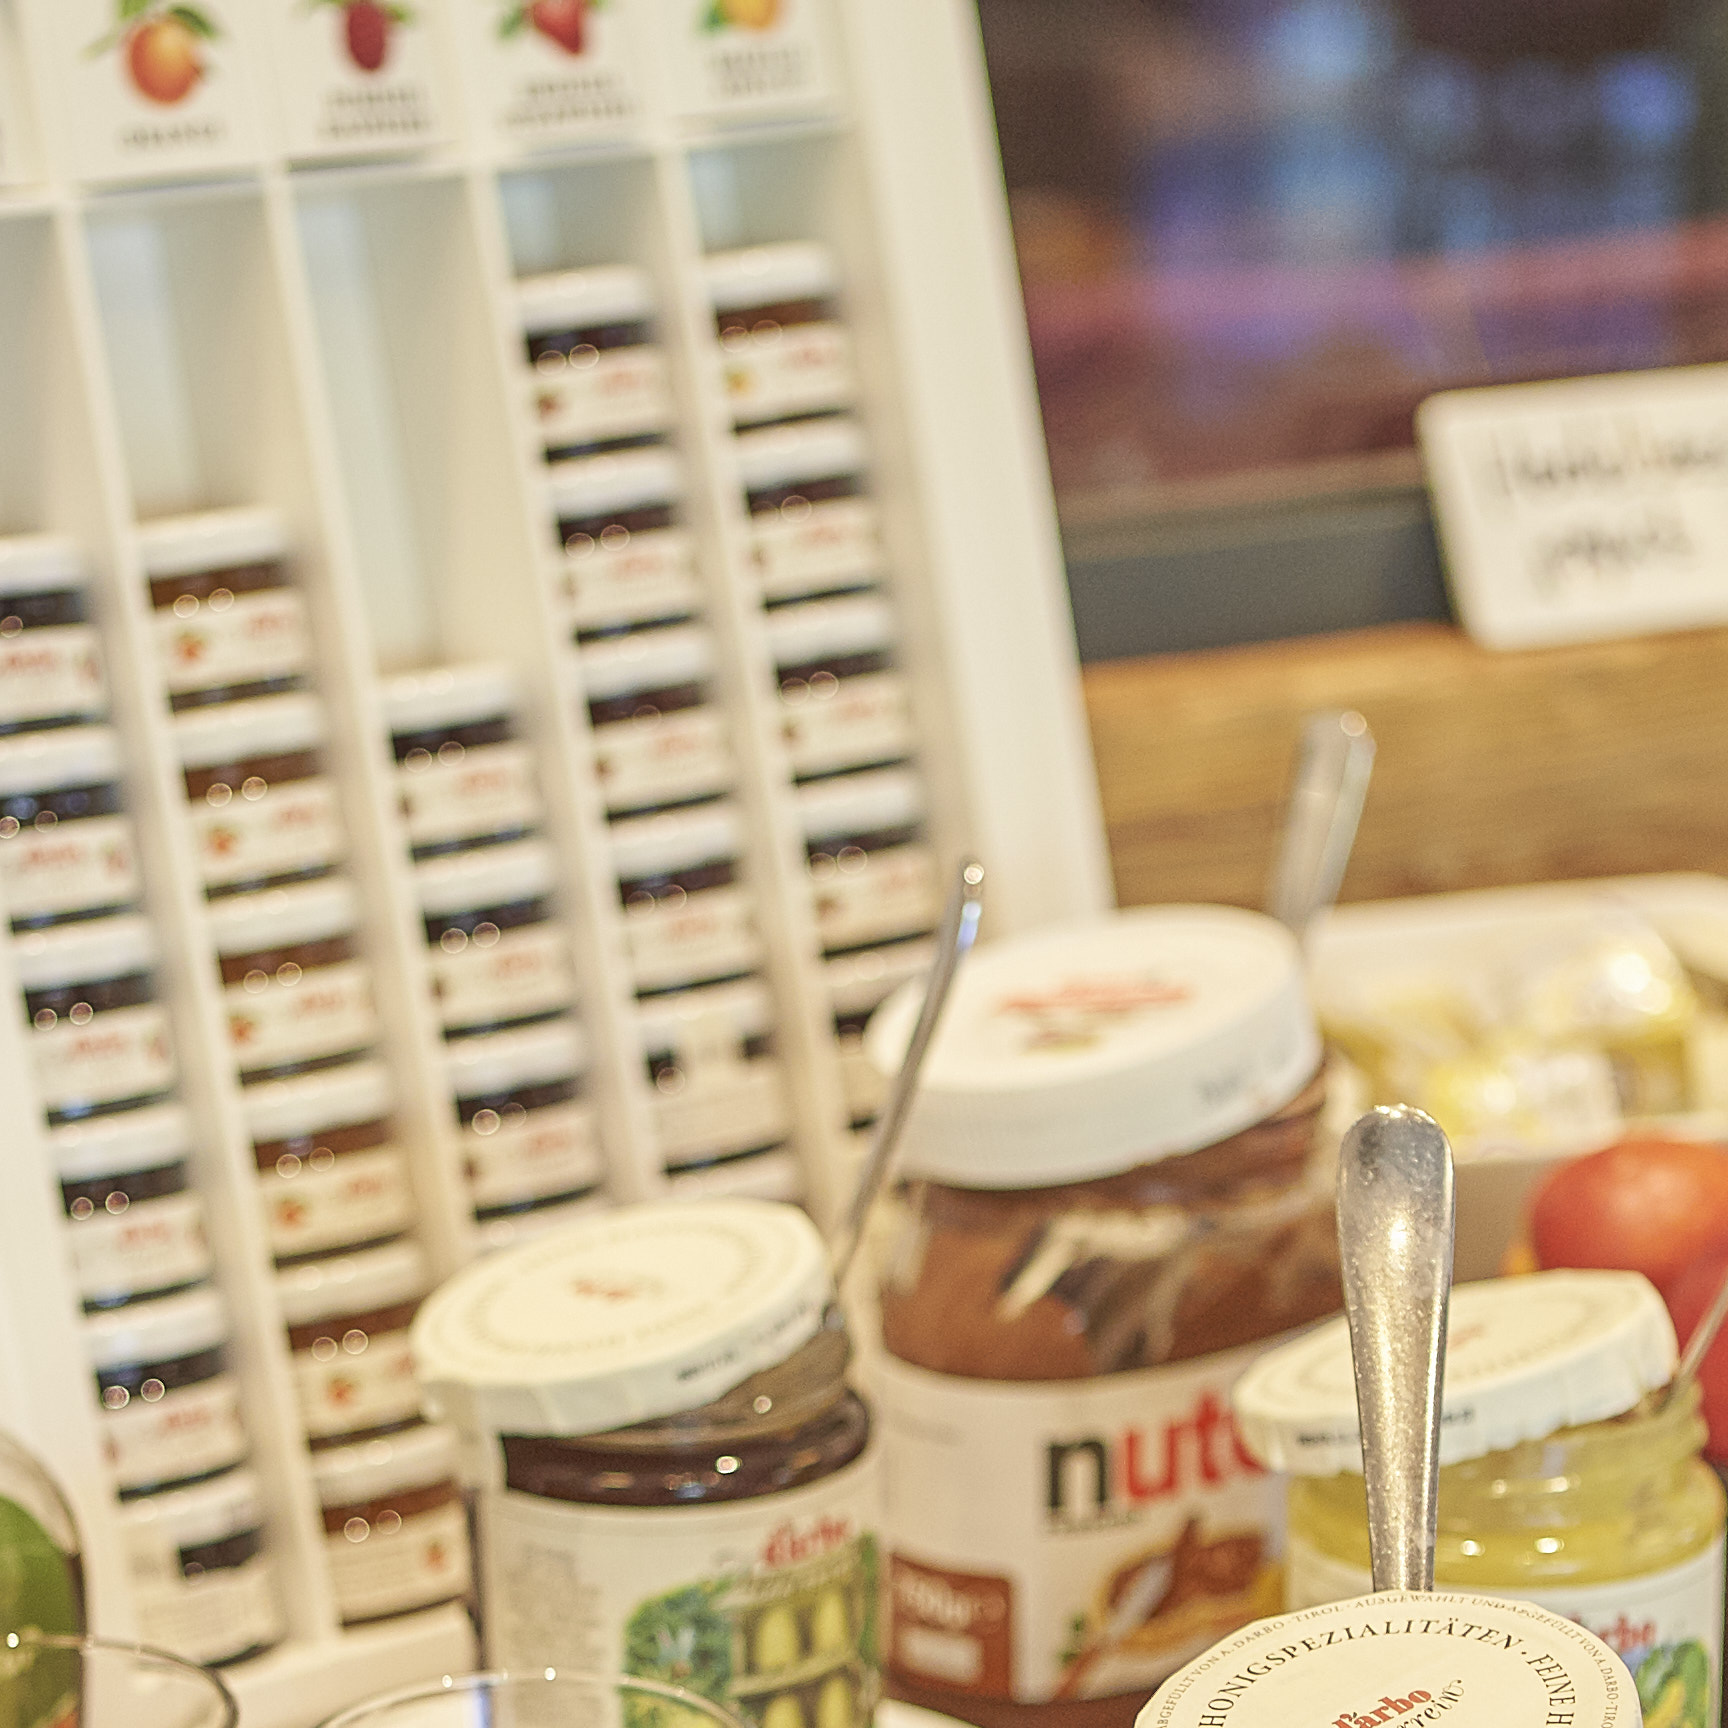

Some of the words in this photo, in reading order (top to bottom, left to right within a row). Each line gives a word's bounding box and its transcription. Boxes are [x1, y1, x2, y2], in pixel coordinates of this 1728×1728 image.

[1193, 1655, 1220, 1676] VON
[1233, 1621, 1285, 1649] DARBO
[1294, 1604, 1345, 1624] TIROL
[1198, 1617, 1524, 1727] HONIGSPEZIALITÄTEN
[1578, 1637, 1603, 1658] VON
[1600, 1666, 1619, 1700] DARBO
[1525, 1653, 1576, 1707] FEINE
